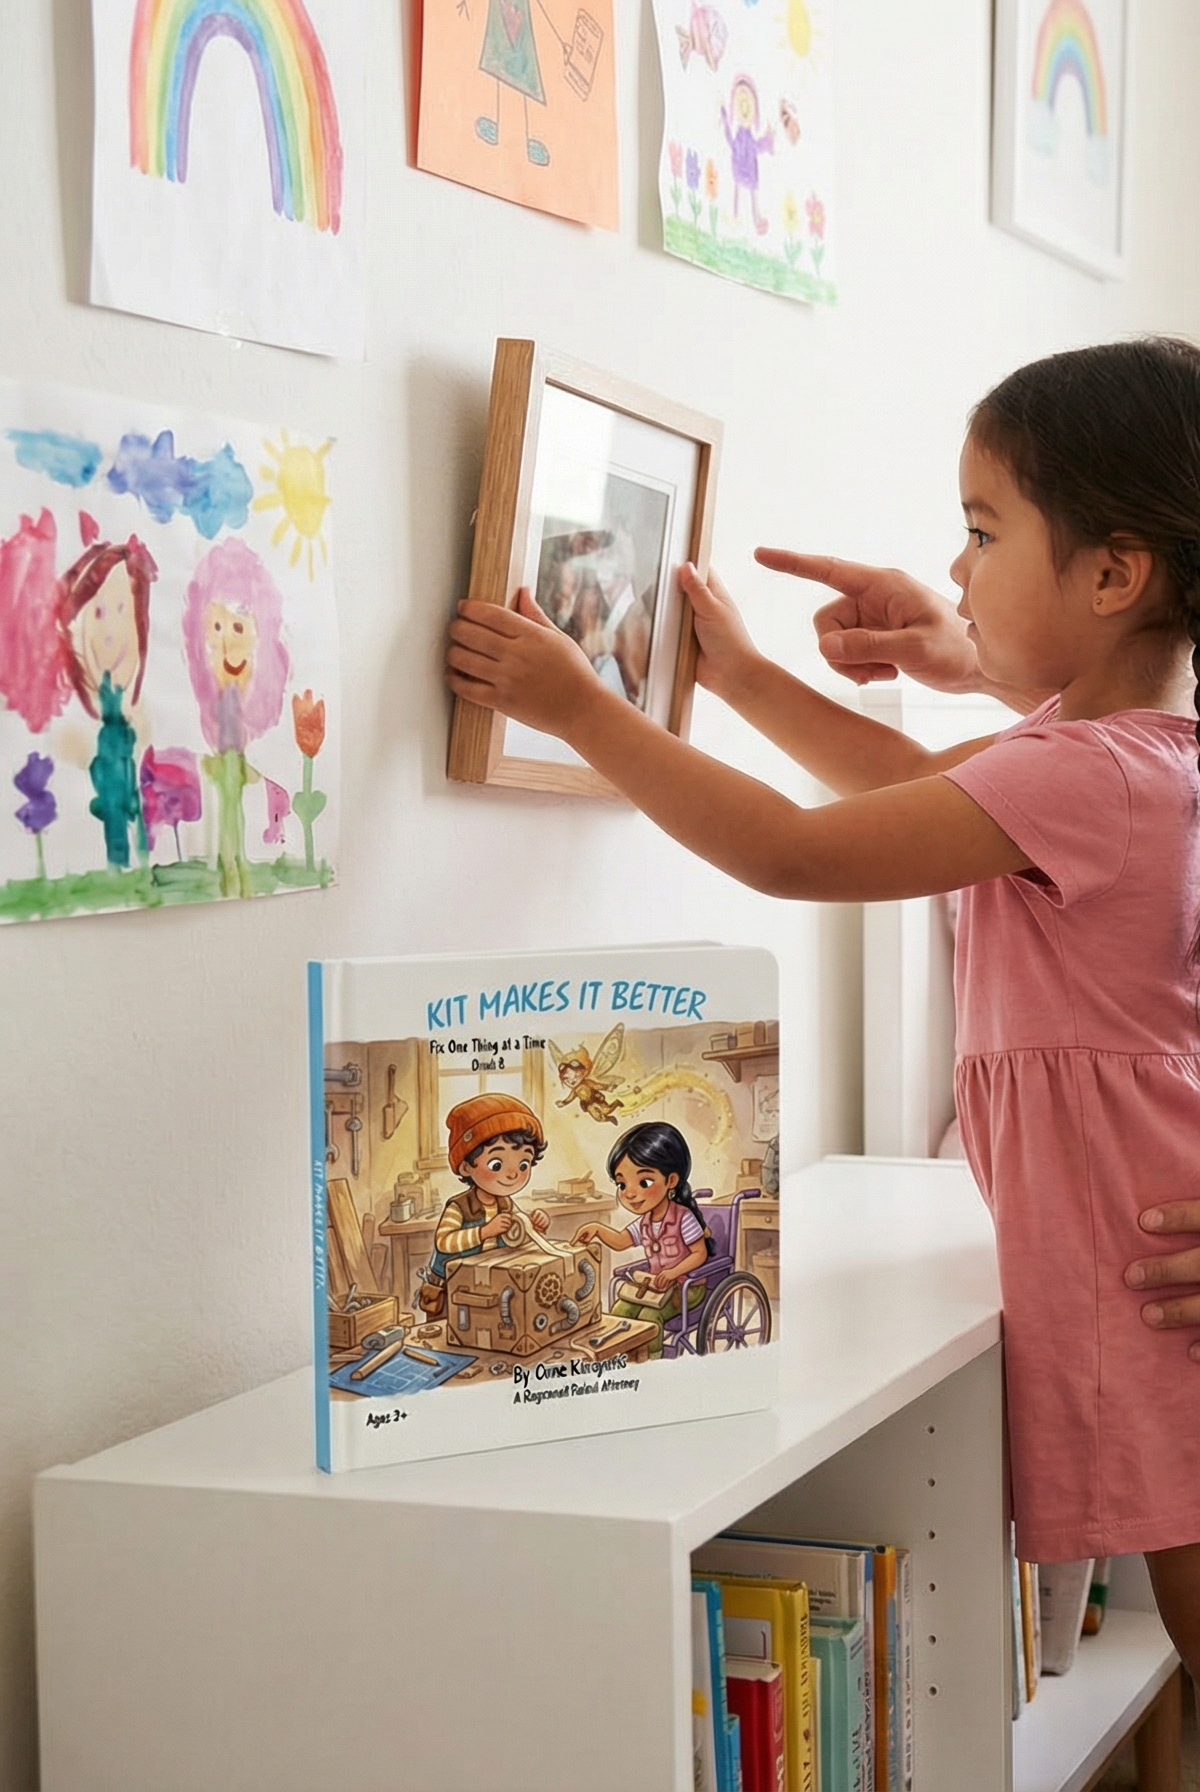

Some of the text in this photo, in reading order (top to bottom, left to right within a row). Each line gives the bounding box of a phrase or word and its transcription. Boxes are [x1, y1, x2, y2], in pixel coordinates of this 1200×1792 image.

[428, 980, 707, 1031] KIT MAKES IT BETTER
[514, 1365, 530, 1388] By
[513, 1391, 521, 1404] A
